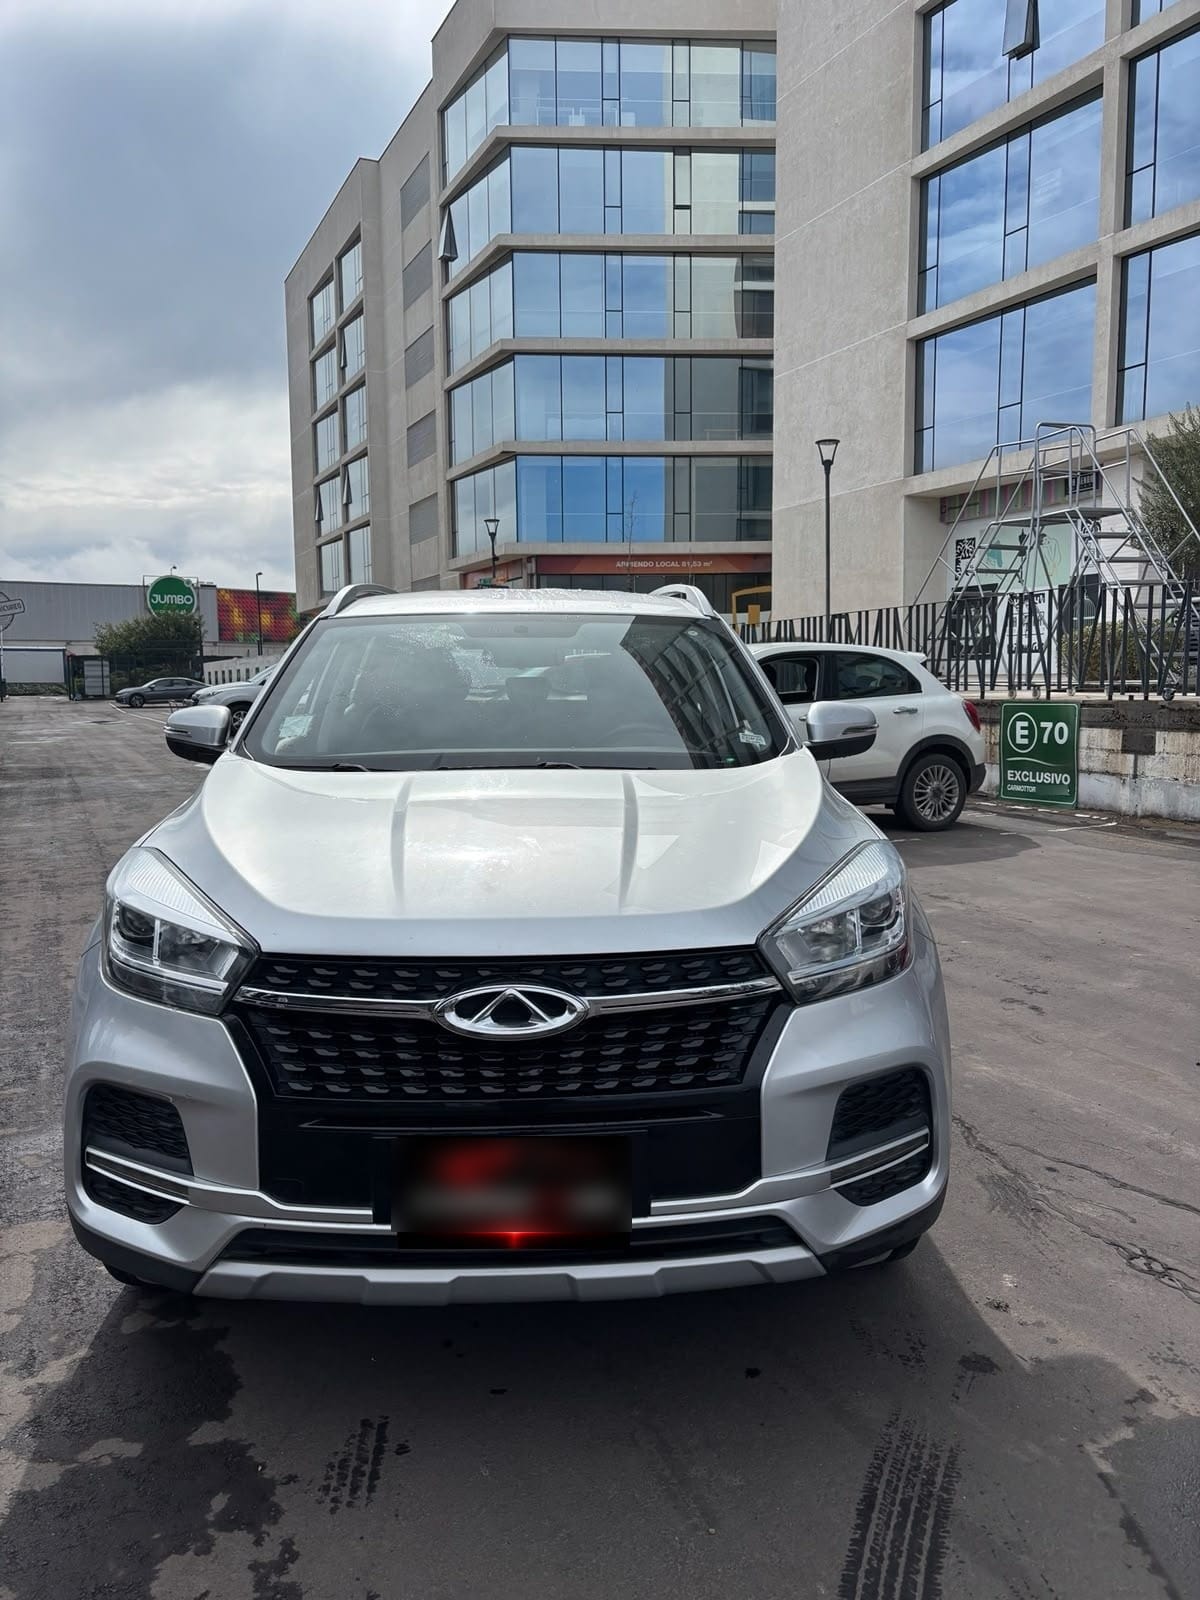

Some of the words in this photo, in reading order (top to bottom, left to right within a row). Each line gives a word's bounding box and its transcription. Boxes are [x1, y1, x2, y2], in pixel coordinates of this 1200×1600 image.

[655, 560, 680, 568] LOCAL
[151, 593, 193, 605] JUMBO
[1015, 721, 1029, 745] E
[1040, 721, 1069, 745] 70
[1007, 770, 1071, 785] EXCLUSIVO
[1006, 784, 1037, 793] CARMOTTOR
